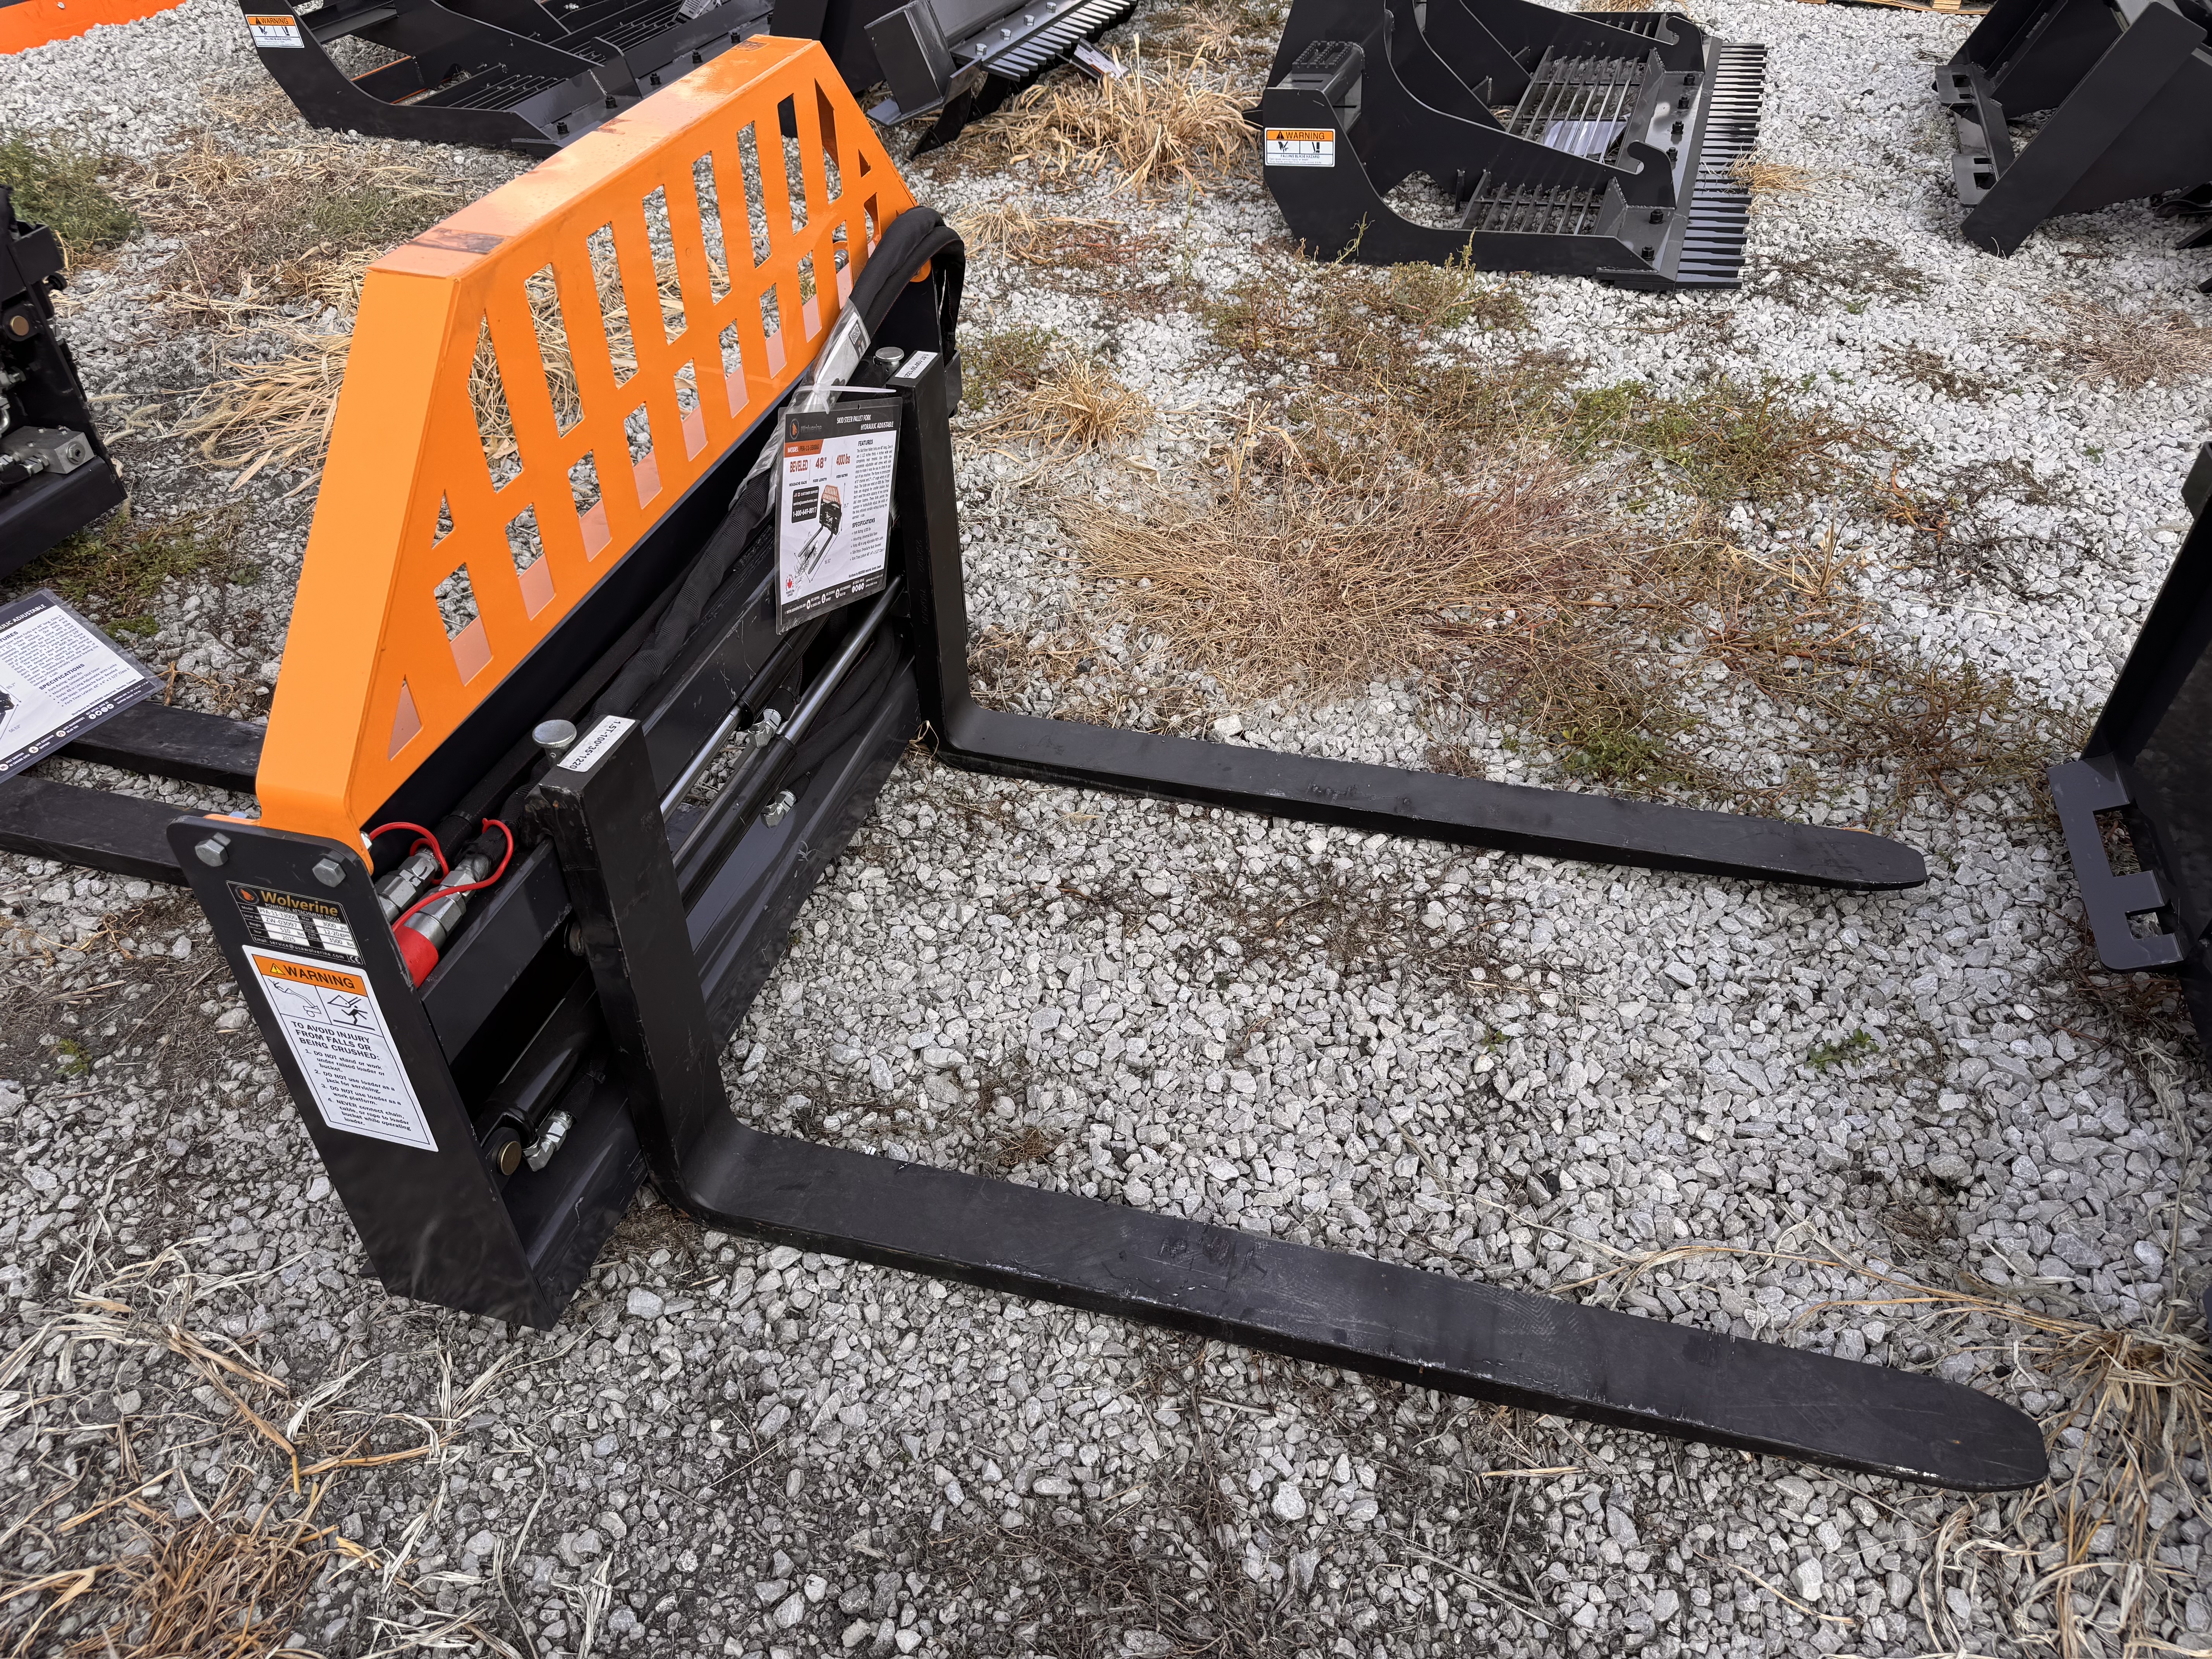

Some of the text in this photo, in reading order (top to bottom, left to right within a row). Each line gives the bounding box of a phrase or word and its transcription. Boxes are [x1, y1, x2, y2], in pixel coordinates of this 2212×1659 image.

[1286, 132, 1325, 140] WARNING
[790, 459, 808, 472] BEVELED
[815, 457, 827, 469] 48"
[836, 454, 845, 465] 4000
[852, 517, 875, 528] SPECIFICATIONS
[0, 604, 46, 630] ULIC ADJUSTABLE
[39, 663, 84, 690] SPECIFICATIONS
[261, 891, 337, 916] Wolverine
[259, 908, 297, 920] PFA-11-3300G
[264, 903, 291, 912] POWERFUL
[292, 908, 324, 919] ATTACHMENT
[265, 917, 297, 927] ZW-03097
[270, 941, 344, 958] service@usawolverine.com
[283, 965, 354, 988] WARNING
[307, 1024, 335, 1035] AVOID
[336, 1030, 369, 1043] INJURY
[295, 1029, 371, 1051] FROM FALLS OR
[299, 1037, 380, 1060] BEING CRUSHED:
[319, 1063, 343, 1072] bucket.
[356, 1066, 376, 1074] loader
[351, 1084, 381, 1094] servicing.
[361, 1079, 380, 1088] loader
[349, 1096, 377, 1105] platform.
[367, 1094, 387, 1102] loader
[336, 1099, 357, 1108] NEVER
[359, 1105, 384, 1114] connect
[341, 1111, 362, 1119] bucket
[343, 1117, 365, 1125] loader.
